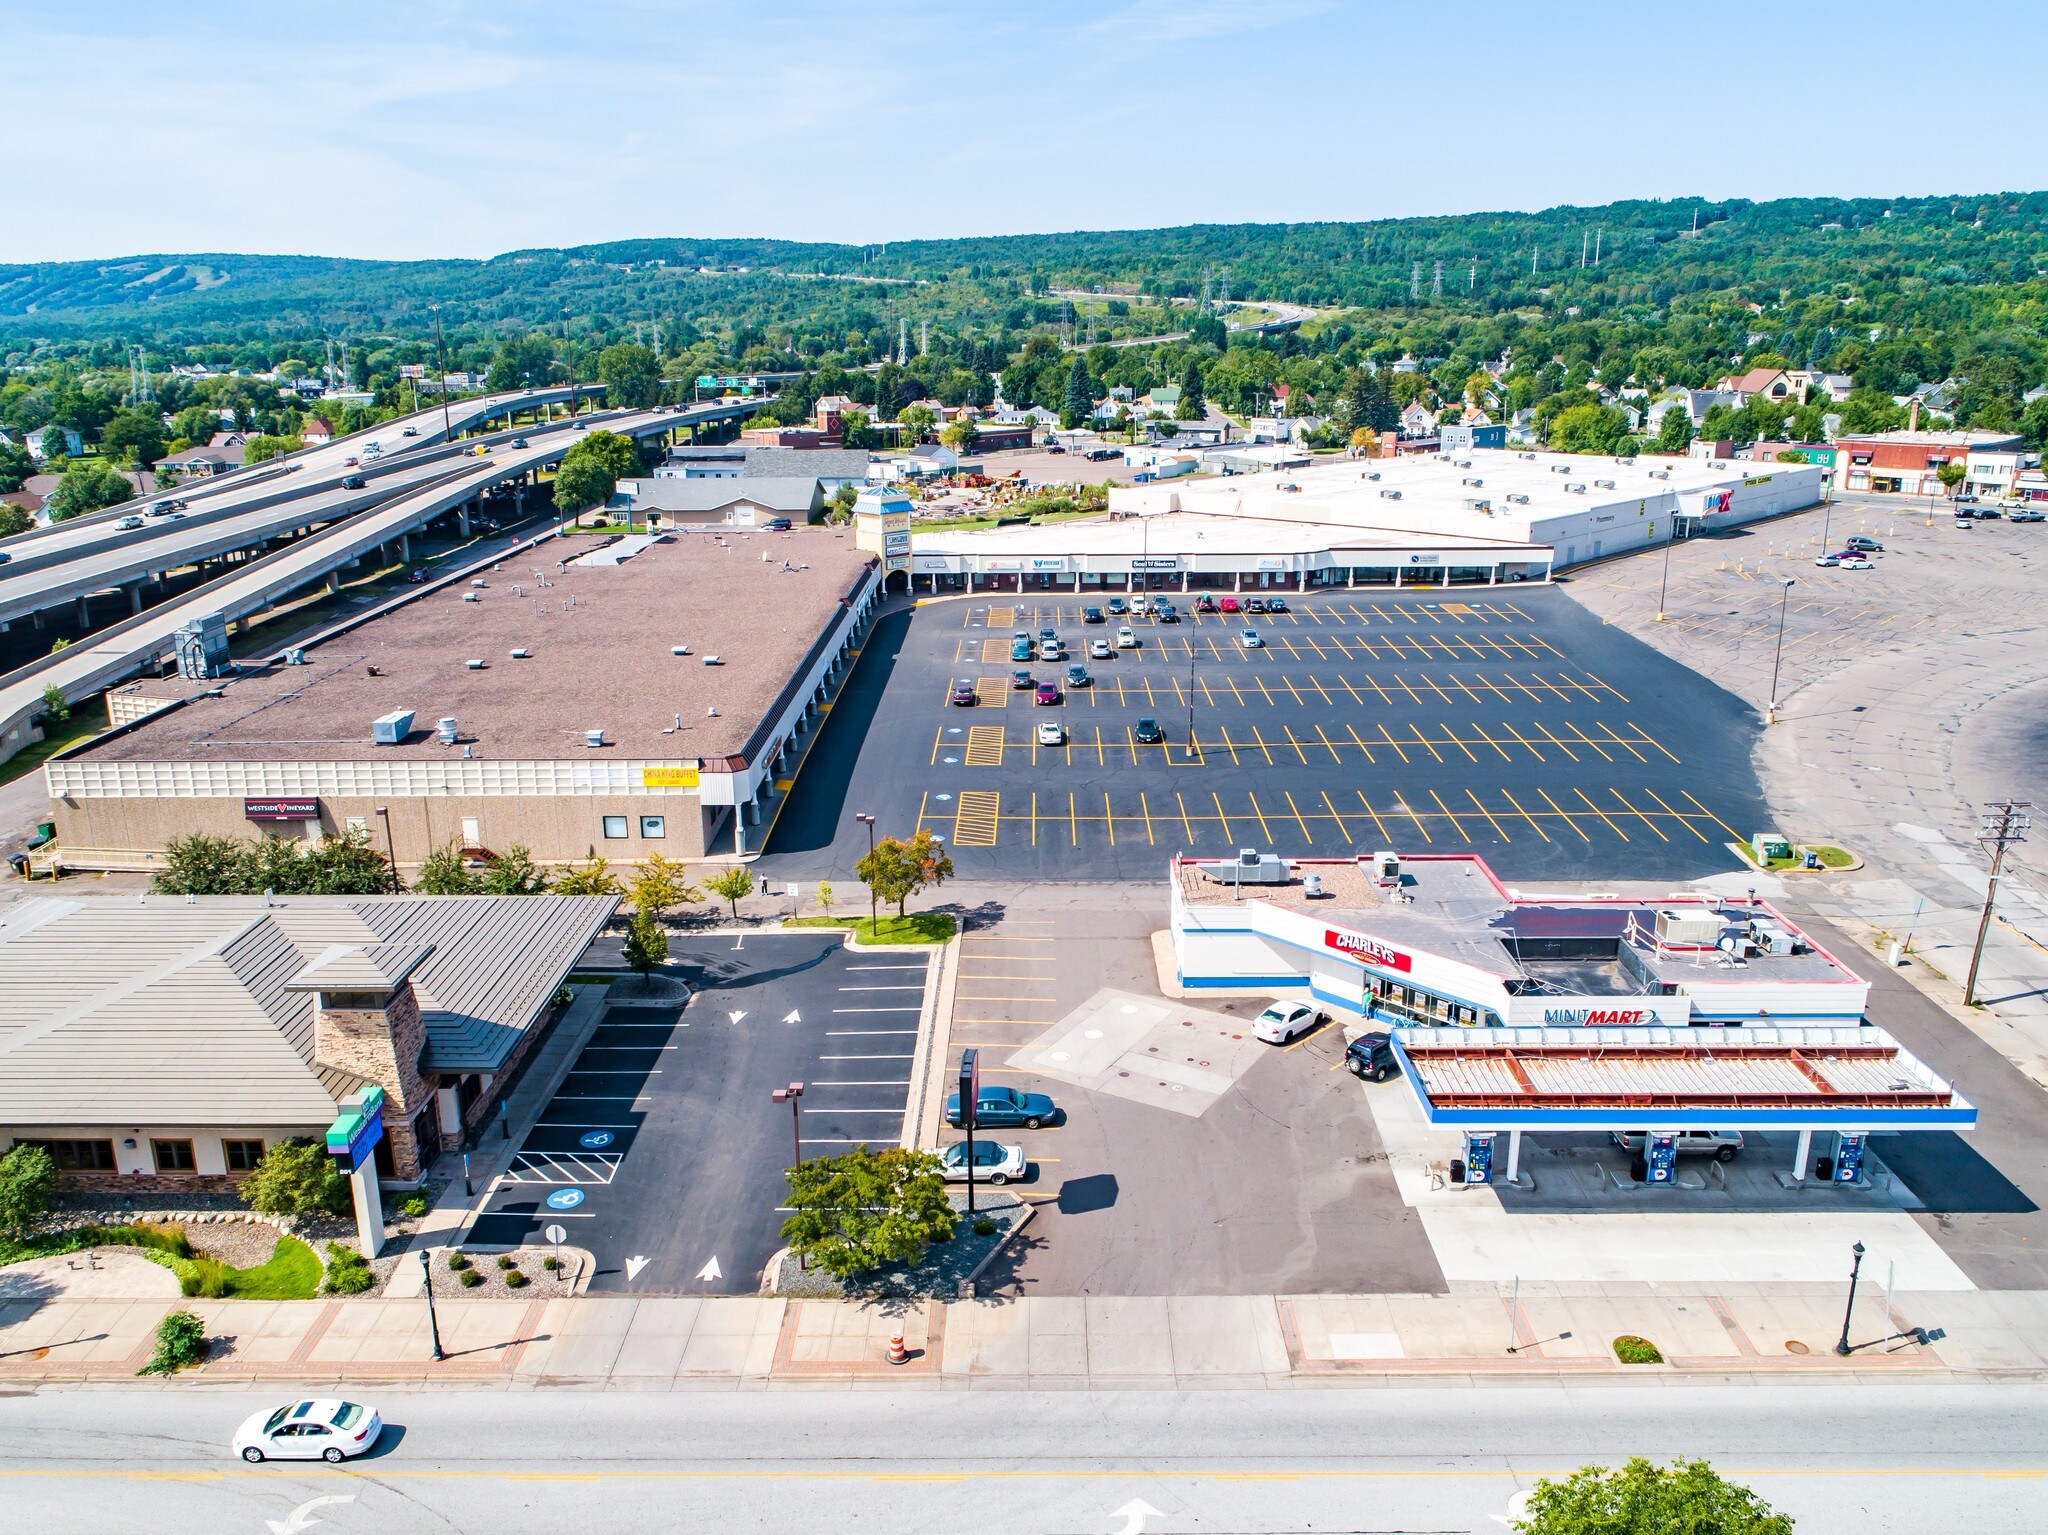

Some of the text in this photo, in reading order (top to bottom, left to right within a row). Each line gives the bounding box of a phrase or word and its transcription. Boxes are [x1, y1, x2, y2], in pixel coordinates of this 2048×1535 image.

[644, 769, 696, 778] CHINA KING BUFFET
[1336, 934, 1395, 964] CHARLEYS
[1544, 1009, 1643, 1026] MINIT MART
